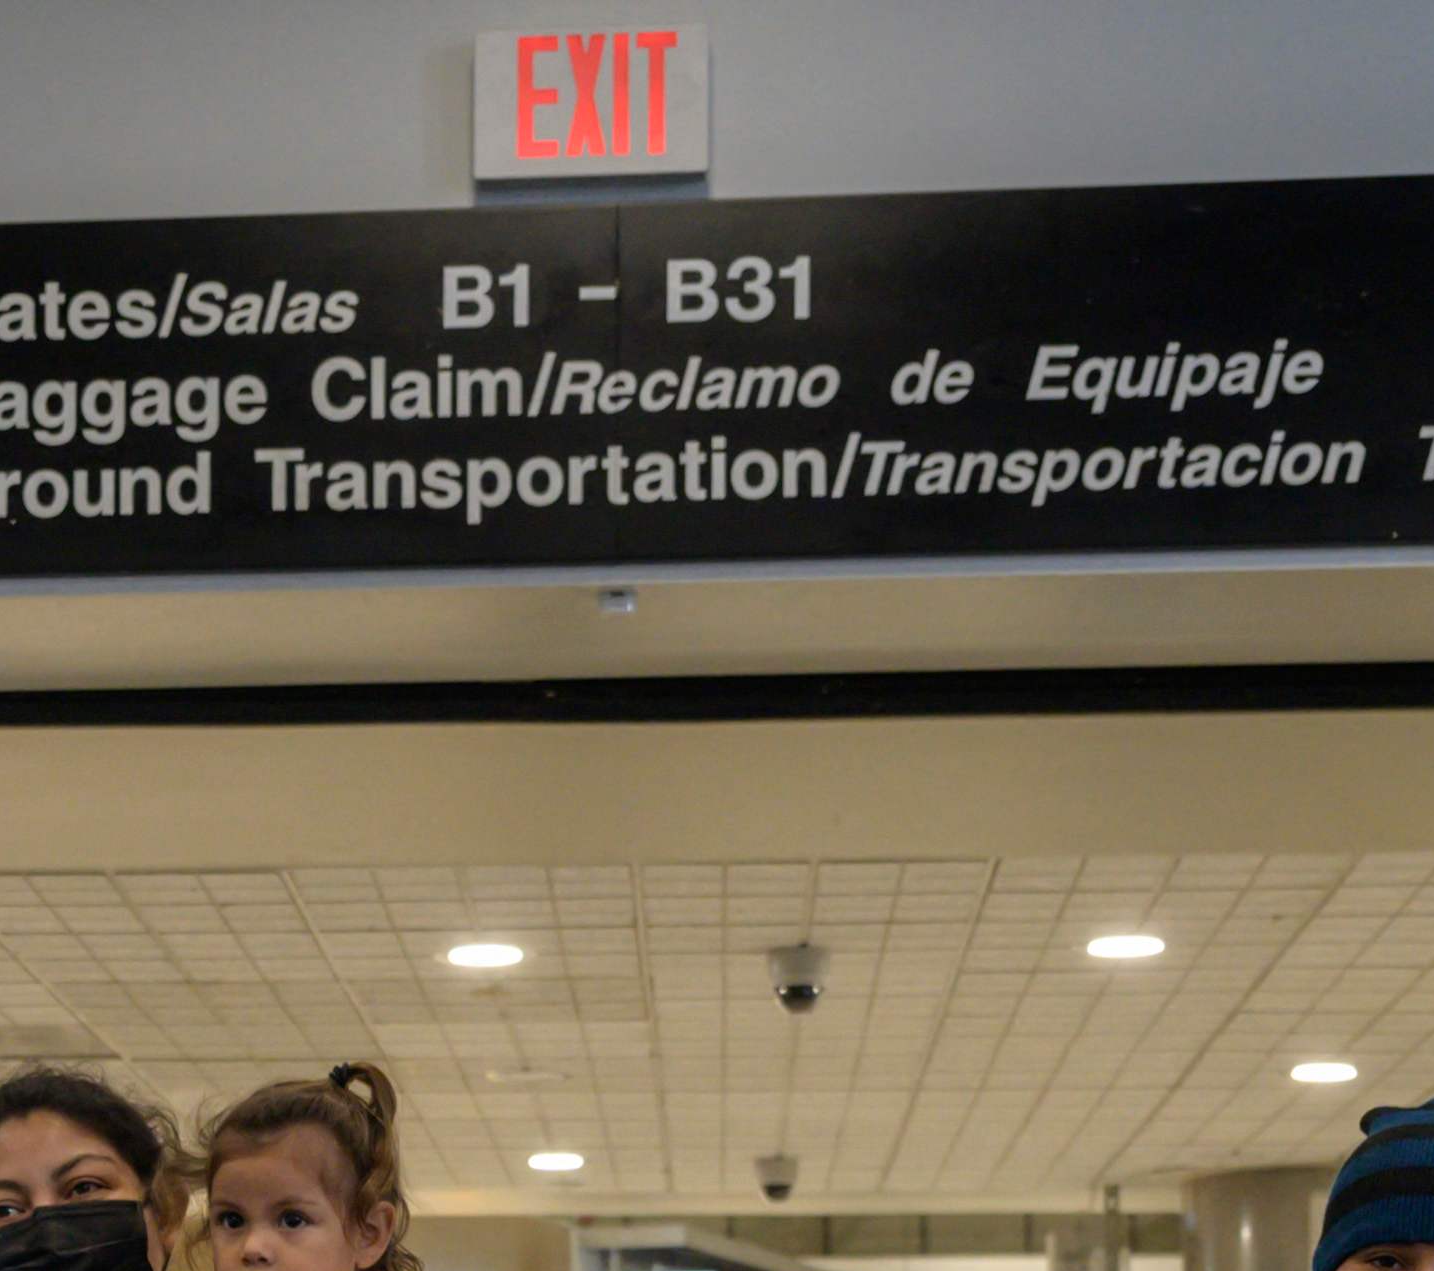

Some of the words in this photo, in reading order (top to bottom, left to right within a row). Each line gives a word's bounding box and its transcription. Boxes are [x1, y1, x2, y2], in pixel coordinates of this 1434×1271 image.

[514, 31, 678, 159] EXIT
[441, 263, 532, 330] B1
[665, 255, 813, 327] B31
[310, 350, 840, 424] Claim/Reclamo
[890, 350, 974, 404] de
[1026, 338, 1324, 414] Equipaje
[254, 432, 1366, 524] Transportation/Transportacion
